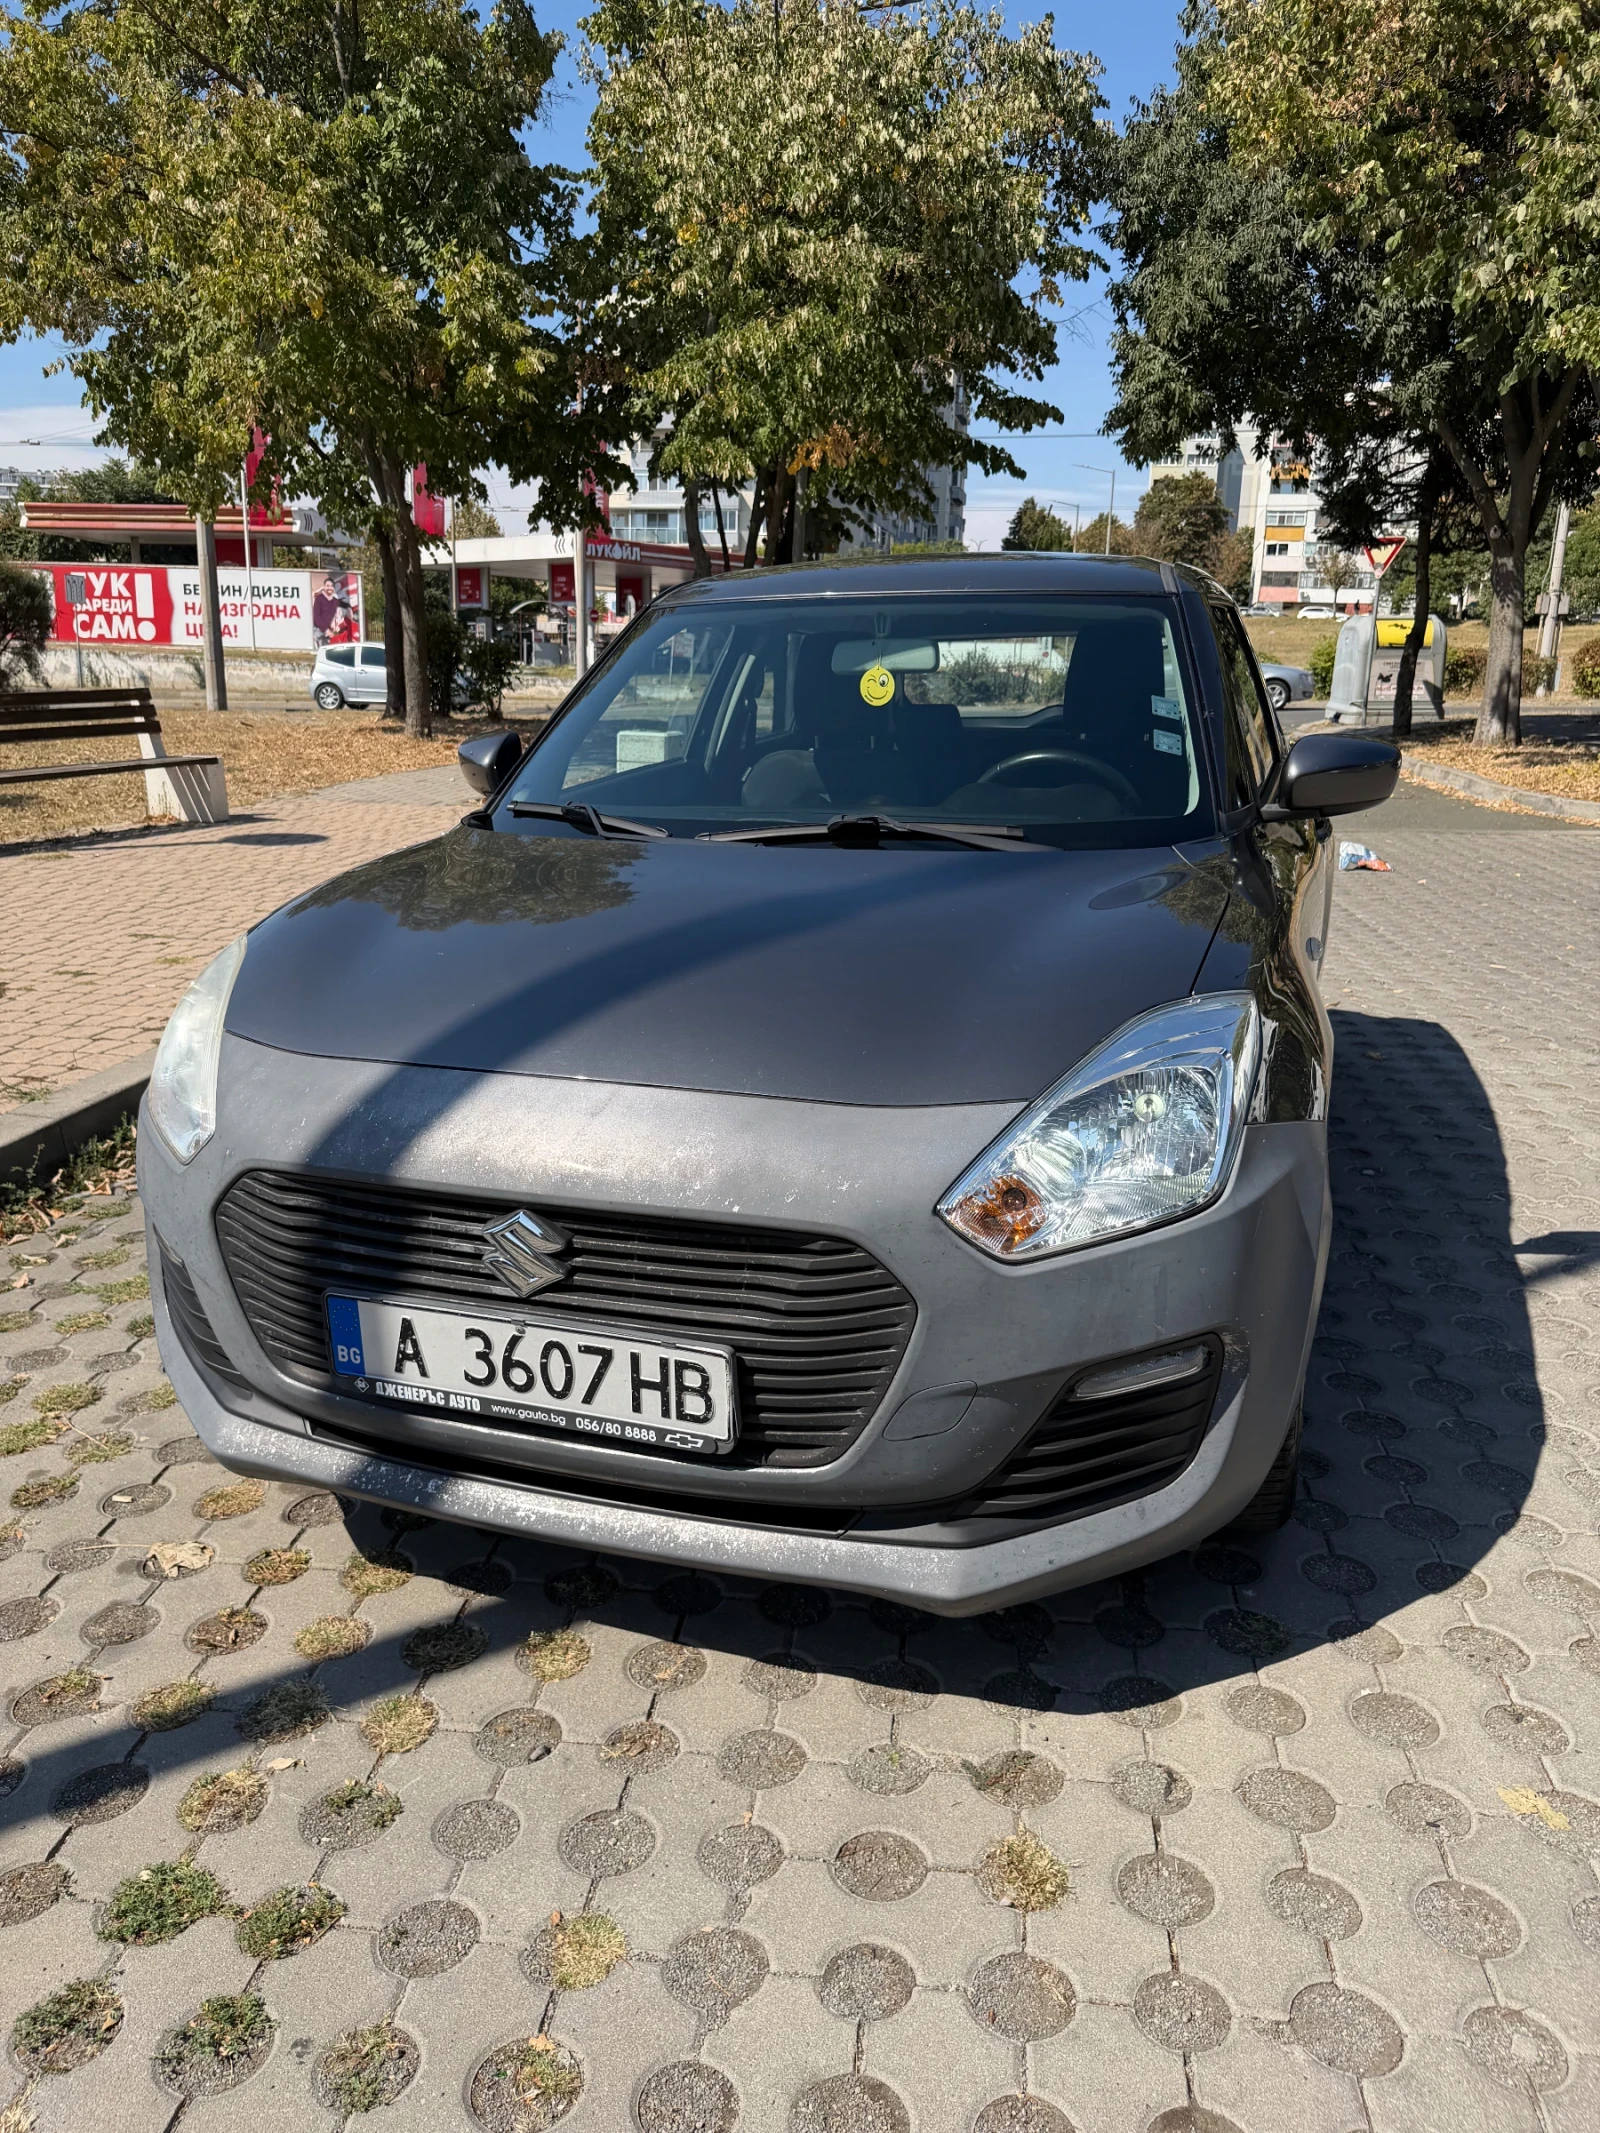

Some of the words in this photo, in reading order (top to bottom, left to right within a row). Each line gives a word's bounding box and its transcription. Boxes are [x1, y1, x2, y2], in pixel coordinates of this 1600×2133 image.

[586, 542, 641, 561] ЛУКОЙЛ
[183, 583, 300, 600] БЕИН/ДИЗЕЛ
[185, 623, 239, 639] ЦА!
[337, 1345, 361, 1365] BG
[463, 1327, 616, 1405] 3607
[375, 1381, 445, 1406] ДЖЕНЕРЪС
[449, 1393, 481, 1413] АУТО
[491, 1403, 567, 1426] www.gauto.bg
[575, 1417, 622, 1436] 056/80
[624, 1426, 657, 1442] 8888
